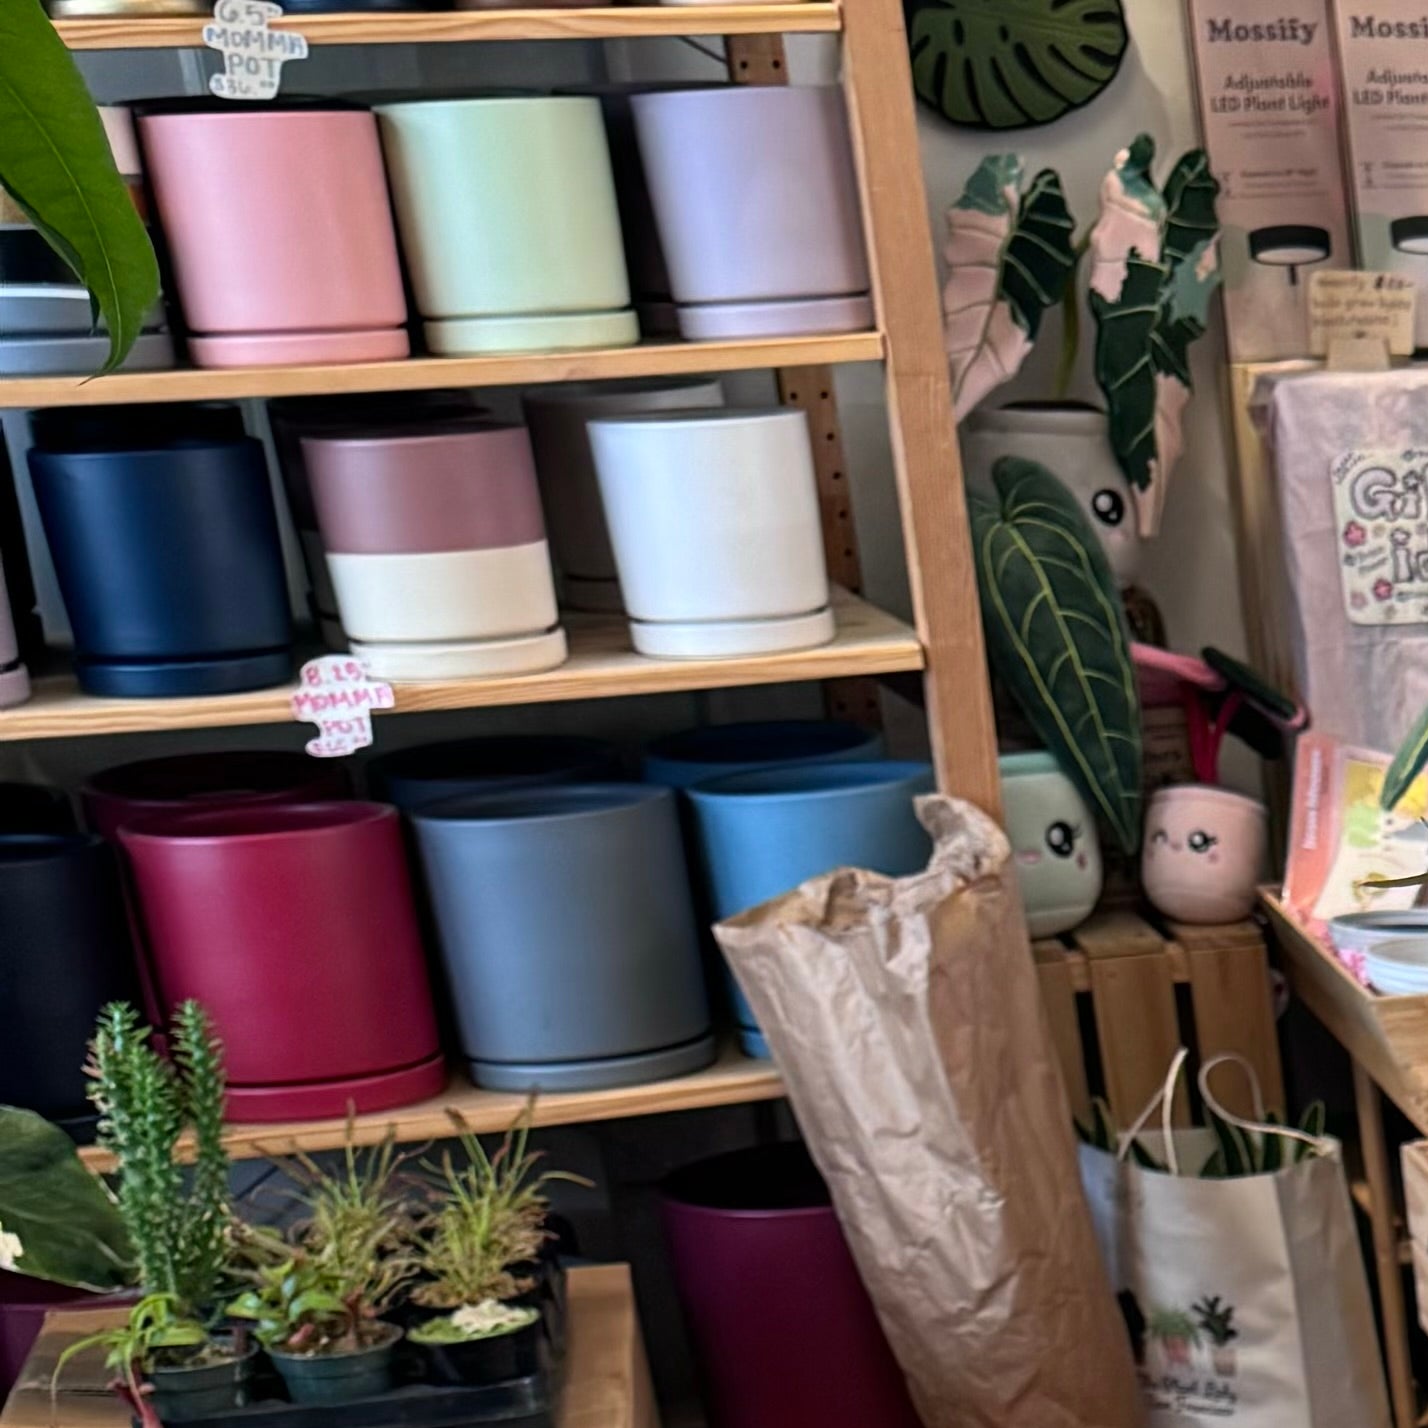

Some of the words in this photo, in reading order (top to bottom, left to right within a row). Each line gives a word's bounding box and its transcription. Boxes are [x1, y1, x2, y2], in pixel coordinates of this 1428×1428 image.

[1207, 17, 1317, 45] Mossify
[228, 54, 276, 79] POT
[1244, 96, 1284, 112] Plant
[1288, 95, 1330, 115] Light
[1386, 91, 1425, 106] Plant
